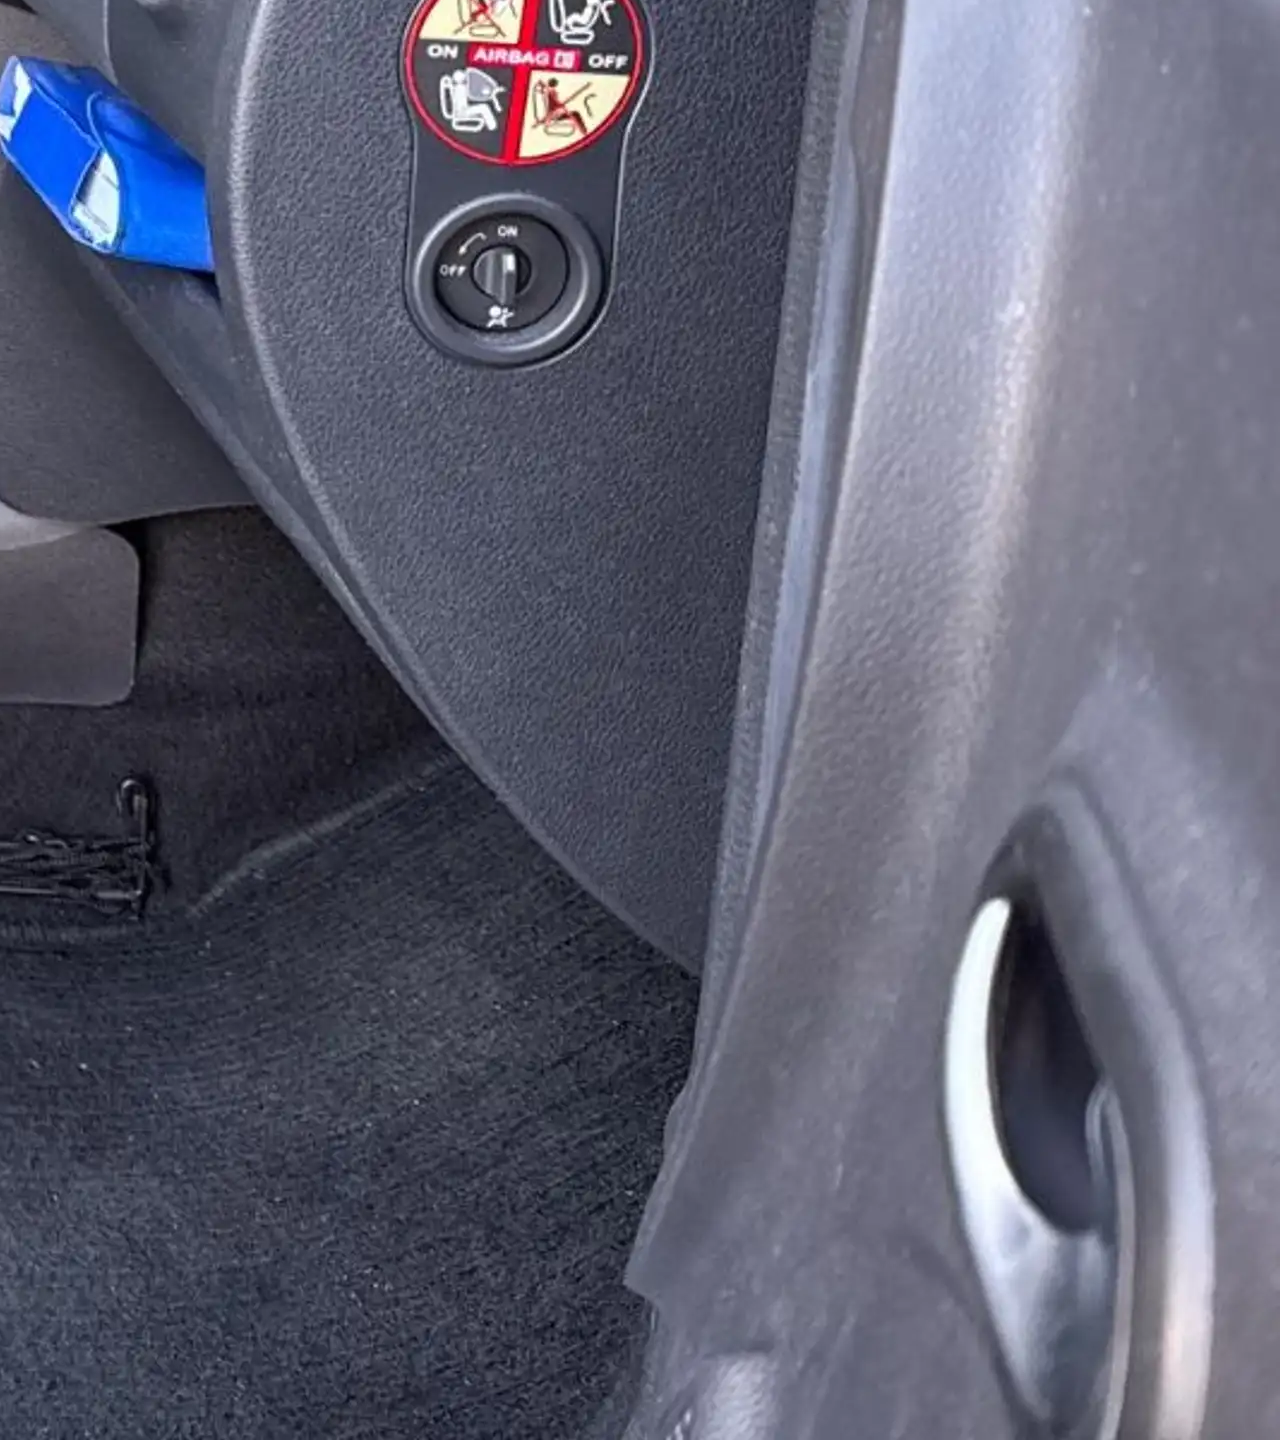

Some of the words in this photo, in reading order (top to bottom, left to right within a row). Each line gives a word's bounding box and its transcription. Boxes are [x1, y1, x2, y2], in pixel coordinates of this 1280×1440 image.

[426, 44, 459, 59] ON
[473, 47, 551, 66] AIRBAG
[588, 54, 629, 70] OFF
[497, 225, 519, 237] ON
[440, 264, 467, 277] OFF
